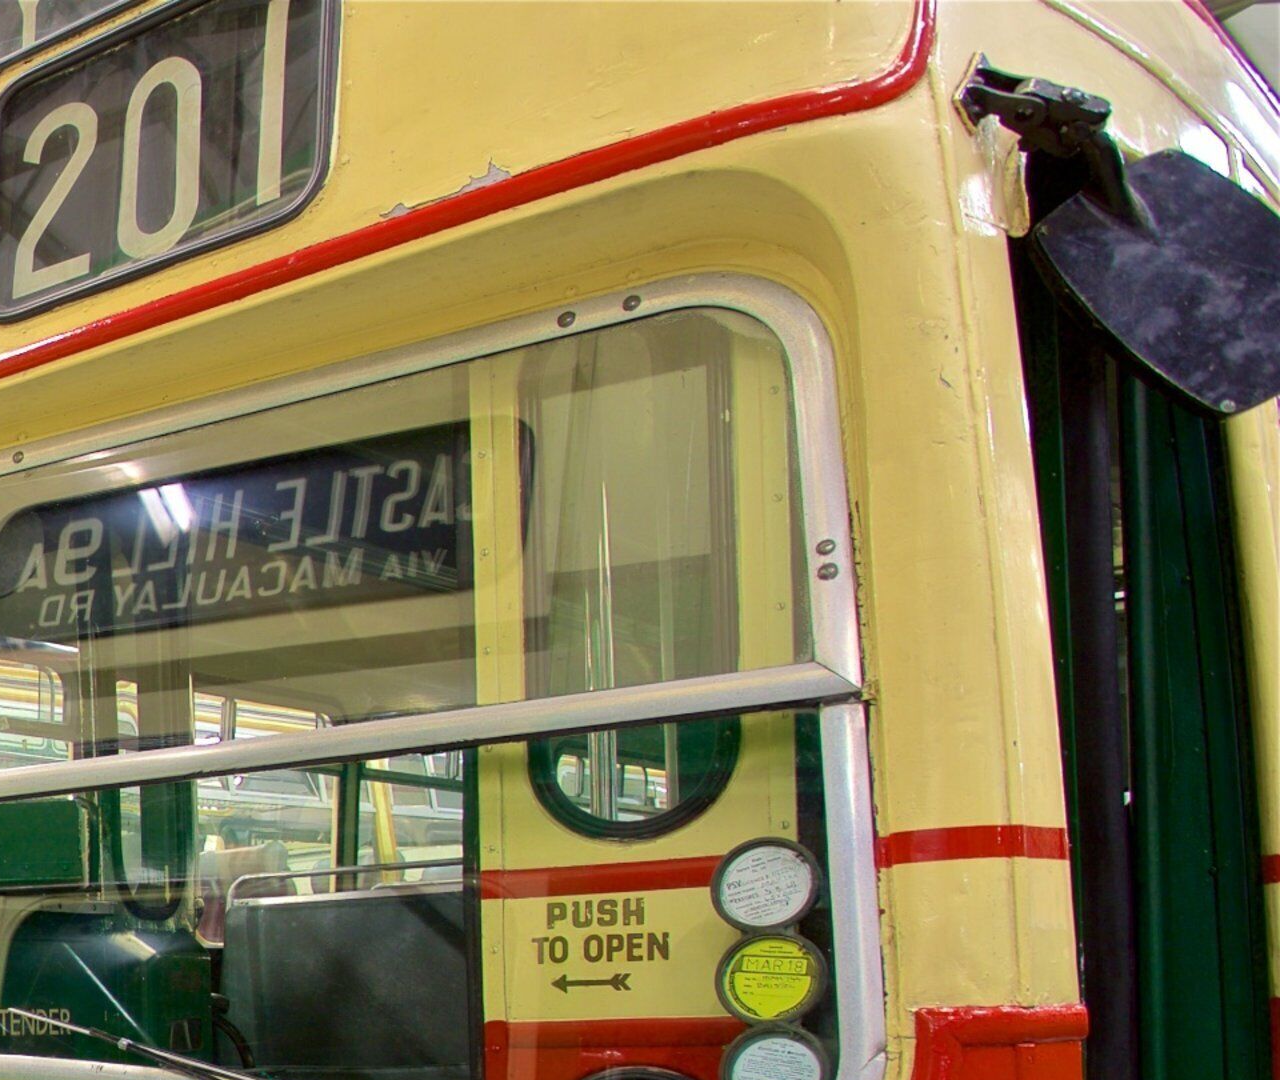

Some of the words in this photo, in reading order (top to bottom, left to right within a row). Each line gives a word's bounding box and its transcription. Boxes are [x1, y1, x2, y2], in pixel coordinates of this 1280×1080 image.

[12, 0, 290, 299] 201
[546, 897, 646, 930] PUSH
[532, 935, 569, 965] TO
[583, 931, 670, 963] OPEN
[746, 958, 784, 971] MAR
